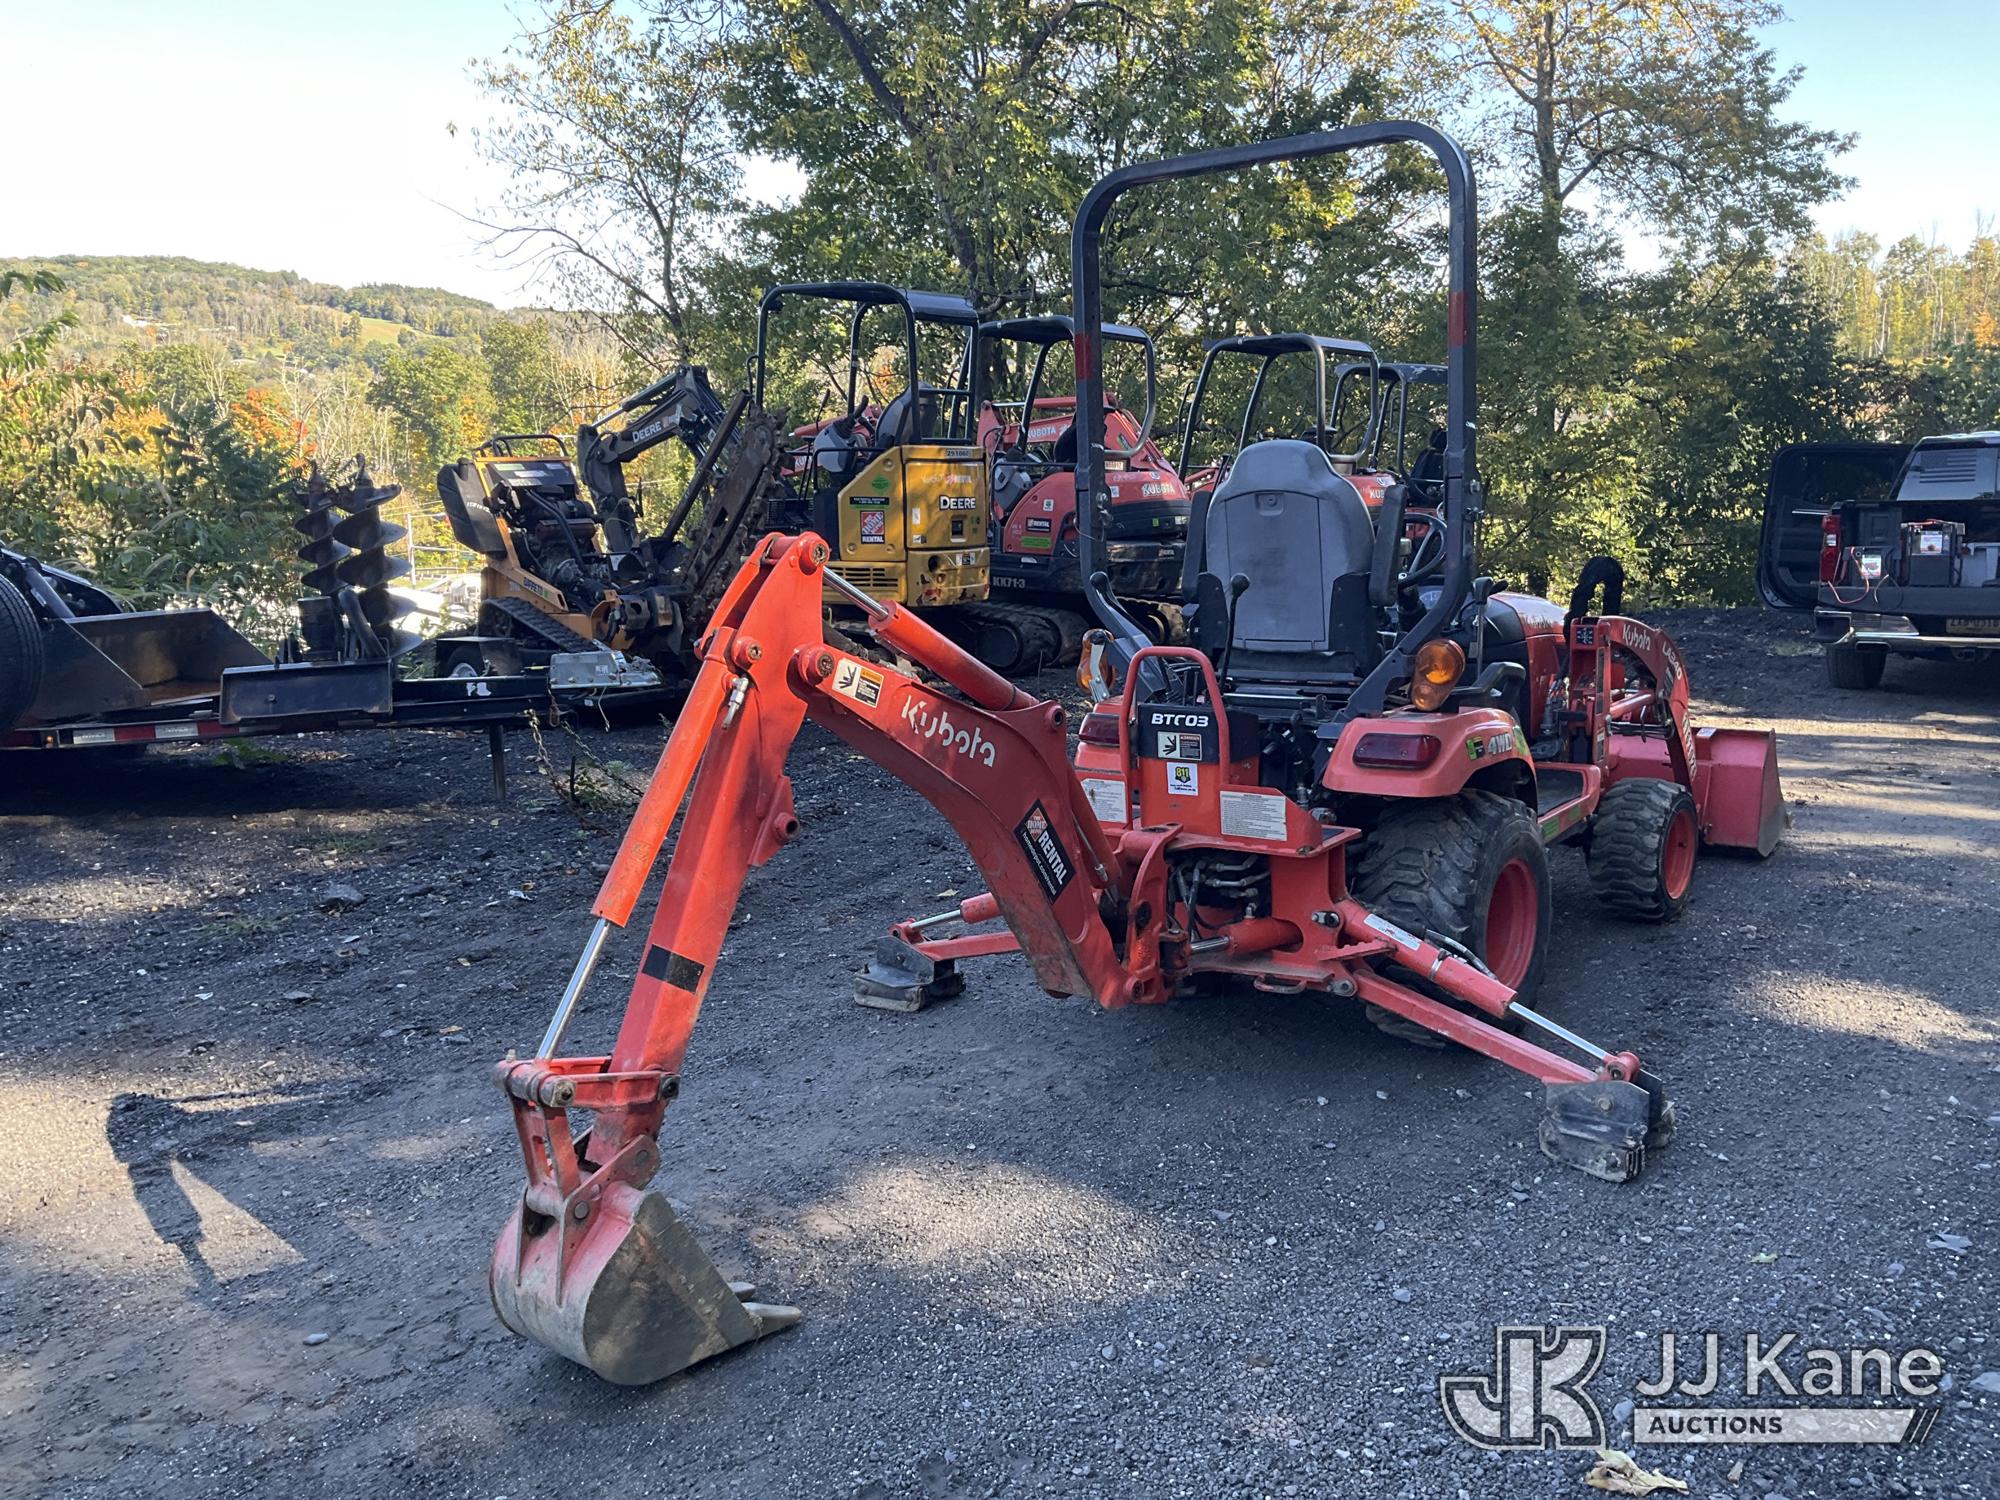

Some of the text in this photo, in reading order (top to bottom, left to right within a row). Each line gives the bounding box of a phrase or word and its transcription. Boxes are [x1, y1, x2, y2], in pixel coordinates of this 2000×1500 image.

[632, 421, 662, 443] DEERE
[1142, 483, 1175, 496] KUBOTA
[939, 495, 976, 510] DEERE
[1622, 623, 1651, 651] Kubota
[901, 695, 996, 768] Kubota
[1487, 732, 1513, 754] 4WD
[1176, 767, 1189, 778] 811
[1027, 820, 1047, 829] HOME
[1038, 830, 1067, 885] RENTAL
